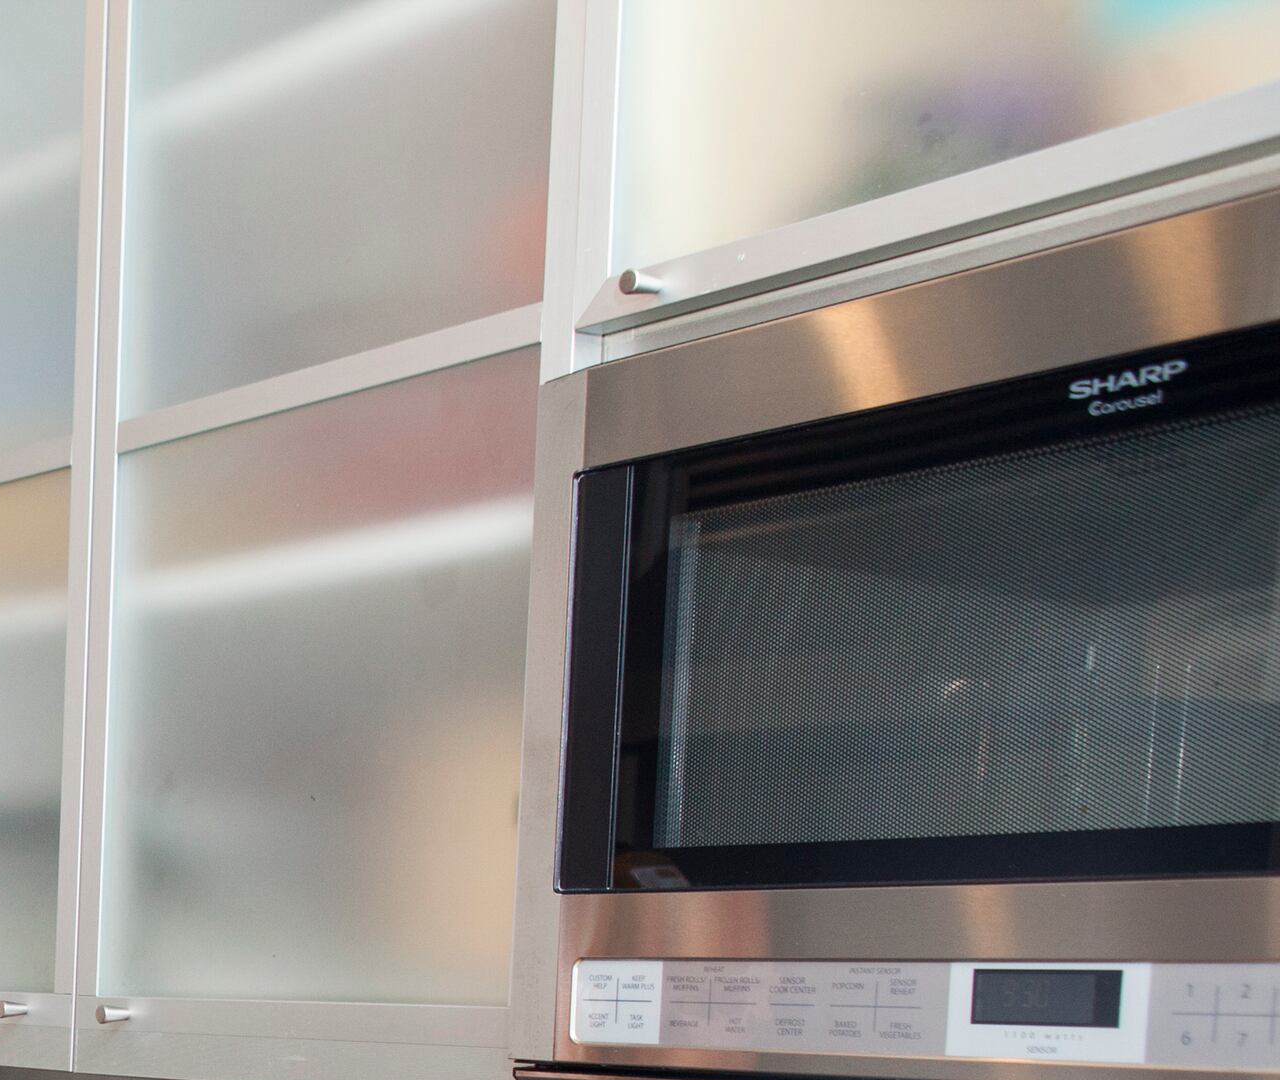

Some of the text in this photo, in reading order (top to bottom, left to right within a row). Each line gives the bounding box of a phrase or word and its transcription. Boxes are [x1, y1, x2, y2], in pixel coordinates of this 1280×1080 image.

[1068, 359, 1188, 400] SHARP
[1088, 389, 1164, 416] Carousel
[779, 976, 806, 984] SENSOR
[831, 982, 864, 990] POPCORN
[769, 985, 816, 995] COOK CENTER
[1186, 983, 1194, 998] 1
[1240, 983, 1252, 999] 2
[628, 1022, 644, 1030] LIGHT
[775, 1018, 805, 1027] DEFROST
[776, 1028, 803, 1036] CENTER
[1181, 1031, 1192, 1046] 6
[1237, 1032, 1248, 1047] 7
